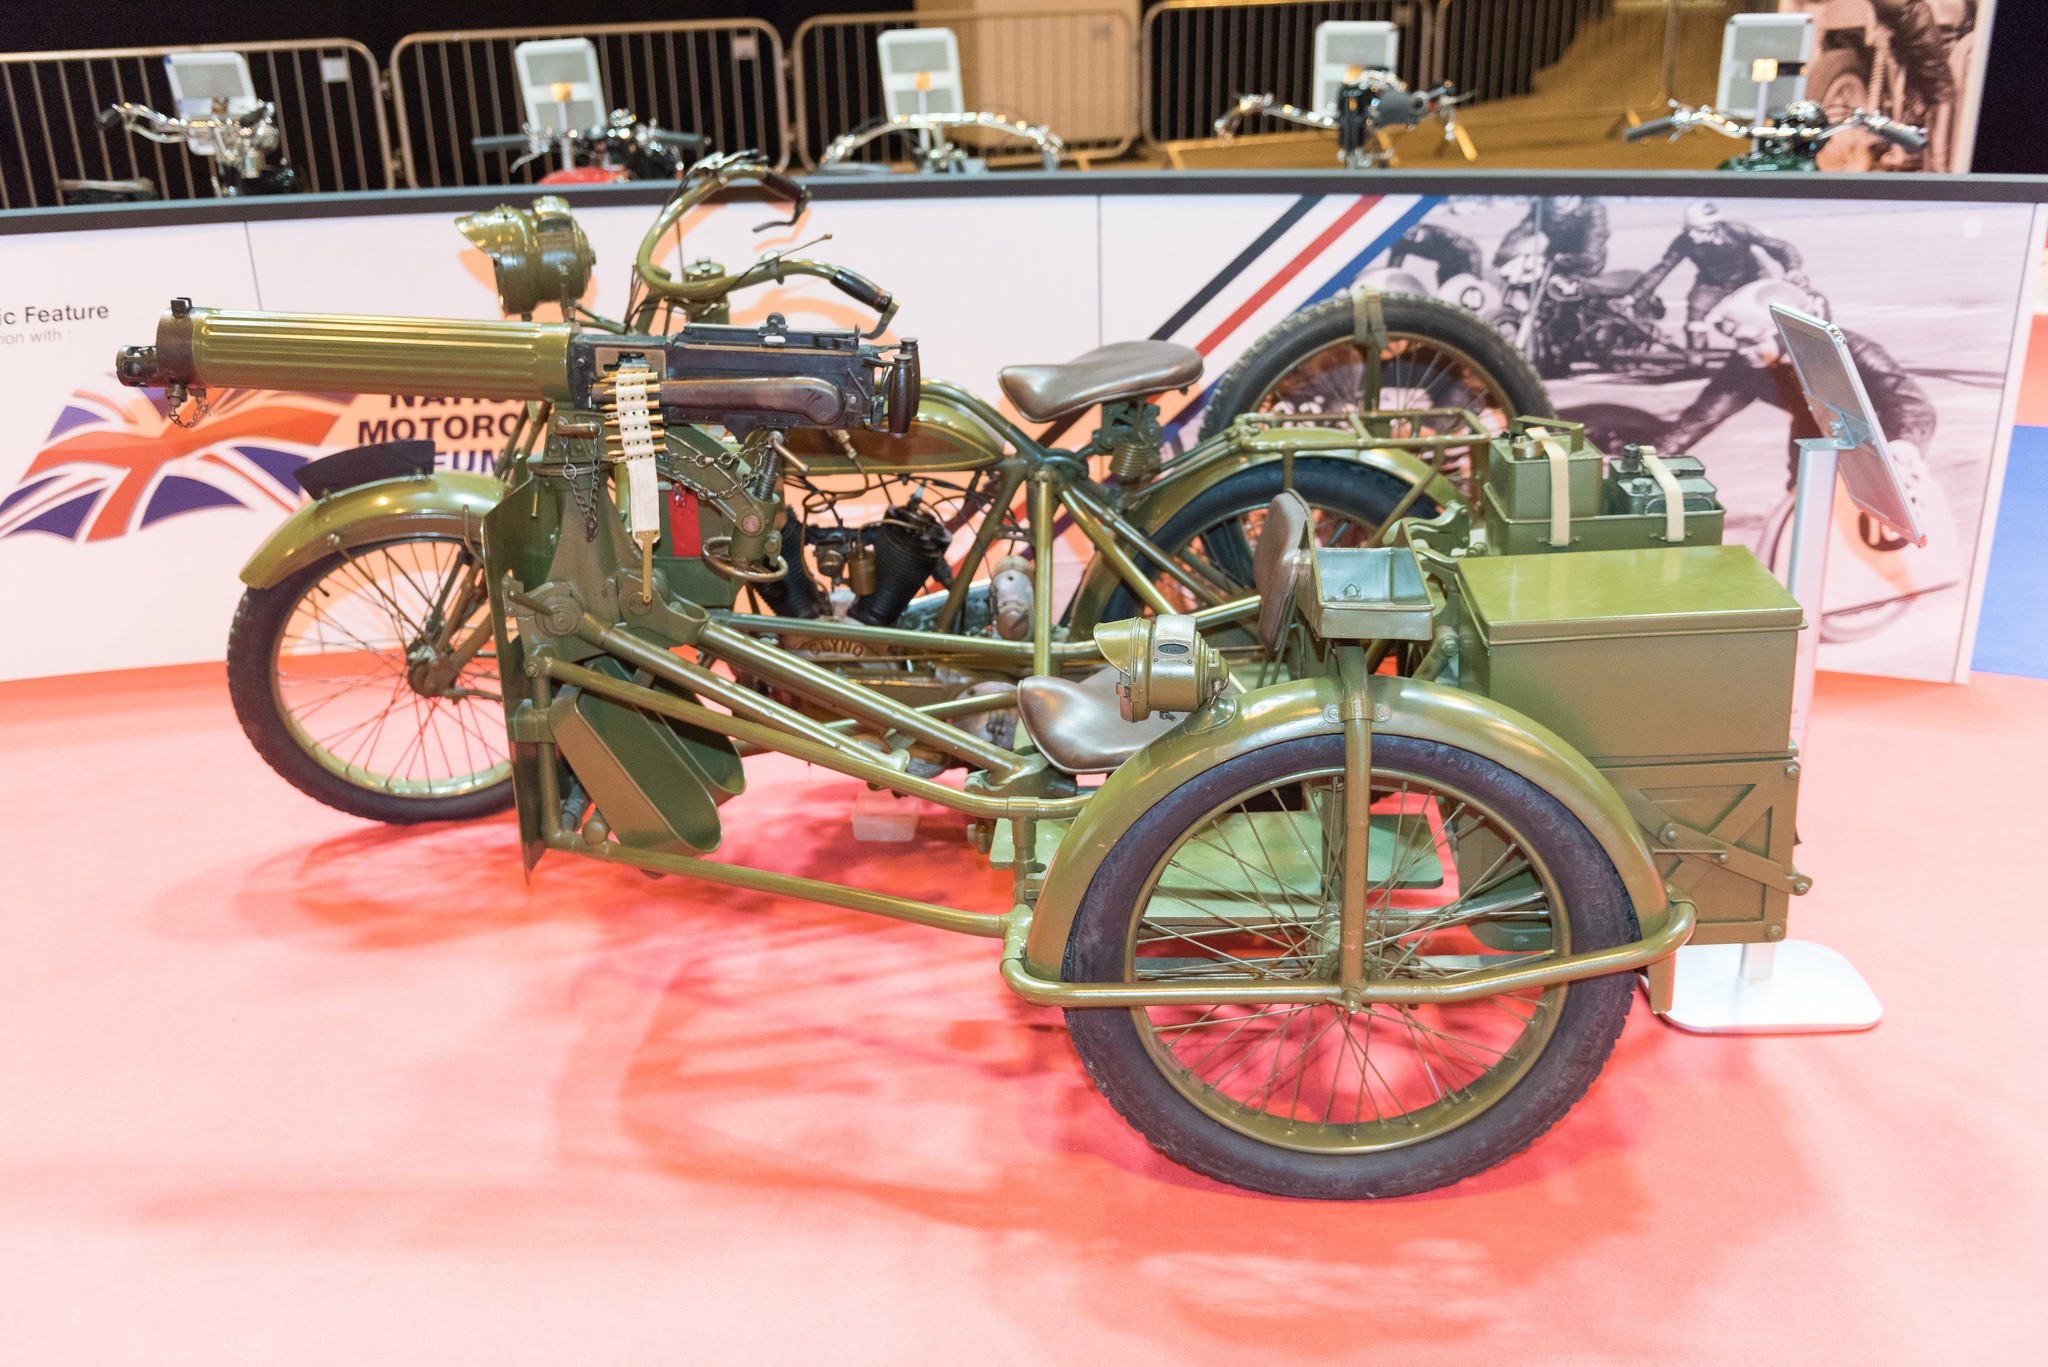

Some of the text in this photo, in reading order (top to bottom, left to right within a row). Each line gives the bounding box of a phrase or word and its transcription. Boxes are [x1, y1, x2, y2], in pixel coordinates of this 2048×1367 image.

[25, 304, 109, 323] Feature
[30, 329, 62, 343] with
[808, 637, 864, 657] CLYNO
